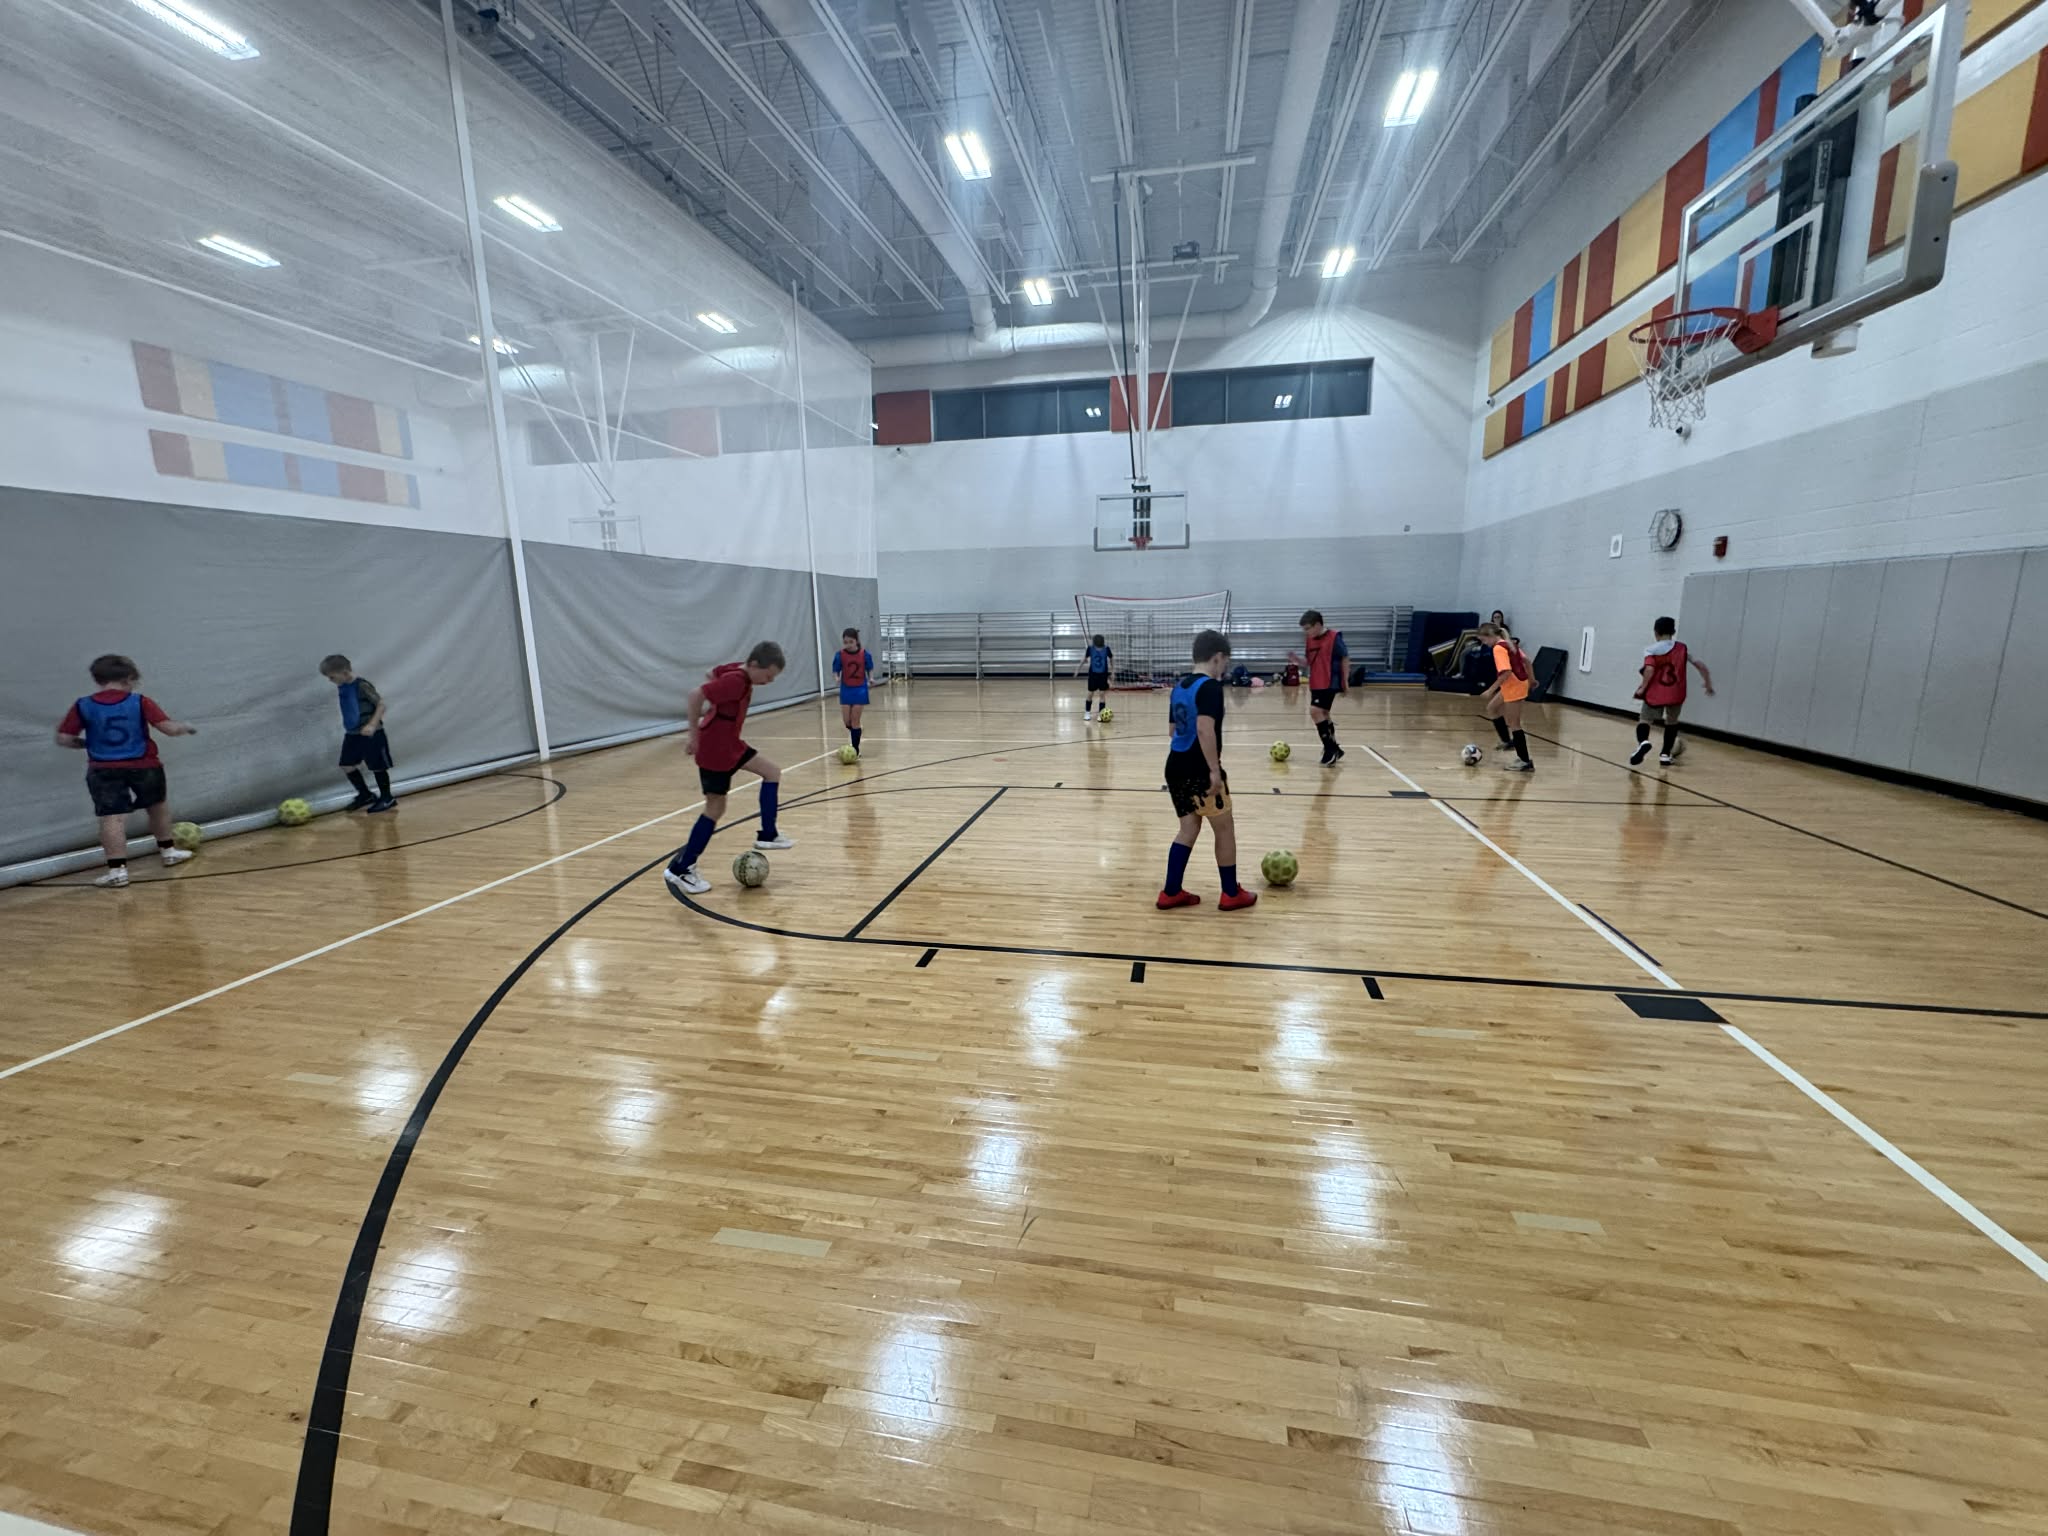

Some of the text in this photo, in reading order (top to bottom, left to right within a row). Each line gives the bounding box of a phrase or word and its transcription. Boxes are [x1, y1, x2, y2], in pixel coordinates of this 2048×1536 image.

[1308, 647, 1320, 665] 7
[847, 661, 861, 679] 2
[103, 715, 130, 747] 5
